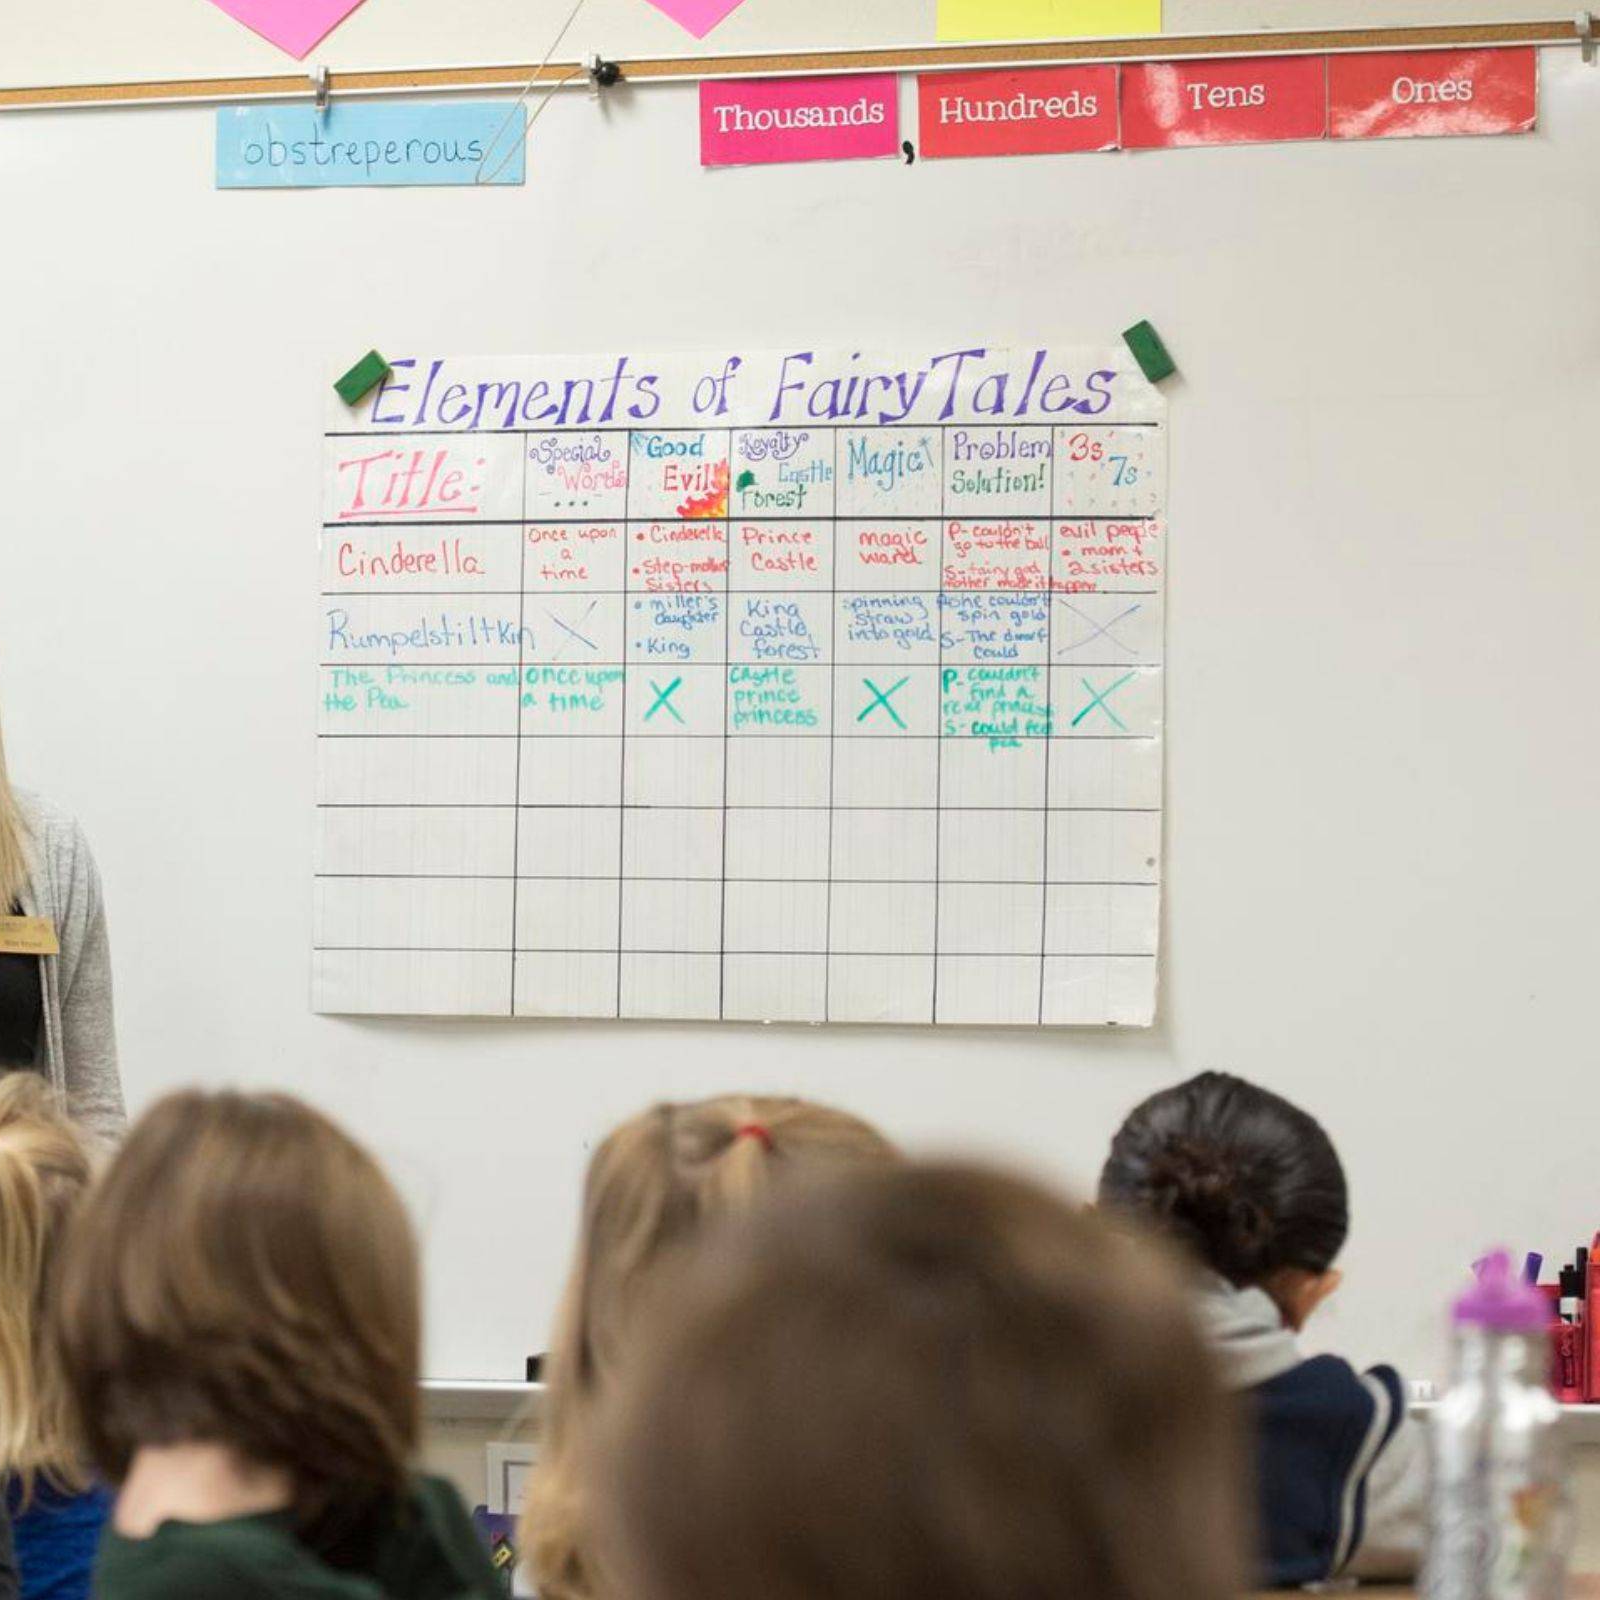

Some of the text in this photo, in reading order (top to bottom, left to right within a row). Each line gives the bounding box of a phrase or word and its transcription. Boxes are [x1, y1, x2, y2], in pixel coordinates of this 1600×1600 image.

[1186, 83, 1265, 110] Tens
[1392, 76, 1473, 105] Ones
[713, 97, 885, 133] Thousands
[939, 91, 1098, 124] Hundreds
[244, 122, 483, 176] obstreperous
[370, 357, 660, 429] Elements
[692, 356, 741, 416] of
[529, 435, 610, 474] Special
[647, 433, 705, 458] Good
[739, 432, 809, 461] Royalty
[953, 431, 1051, 462] Problem
[338, 450, 486, 510] Title:
[558, 460, 626, 491] Words
[779, 460, 832, 483] Castle
[951, 462, 1046, 494] Solution!
[742, 483, 807, 510] Forest
[529, 528, 616, 547] Once upon
[742, 527, 812, 545] Prince
[860, 527, 927, 549] magic
[1060, 523, 1095, 538] evil
[339, 539, 484, 576] Cinderella
[561, 549, 573, 559] a
[752, 552, 818, 571] Castle
[540, 563, 588, 580] time
[648, 637, 690, 658] King
[331, 668, 519, 687] The Princess and
[325, 686, 407, 711] the Pea
[549, 692, 604, 711] time
